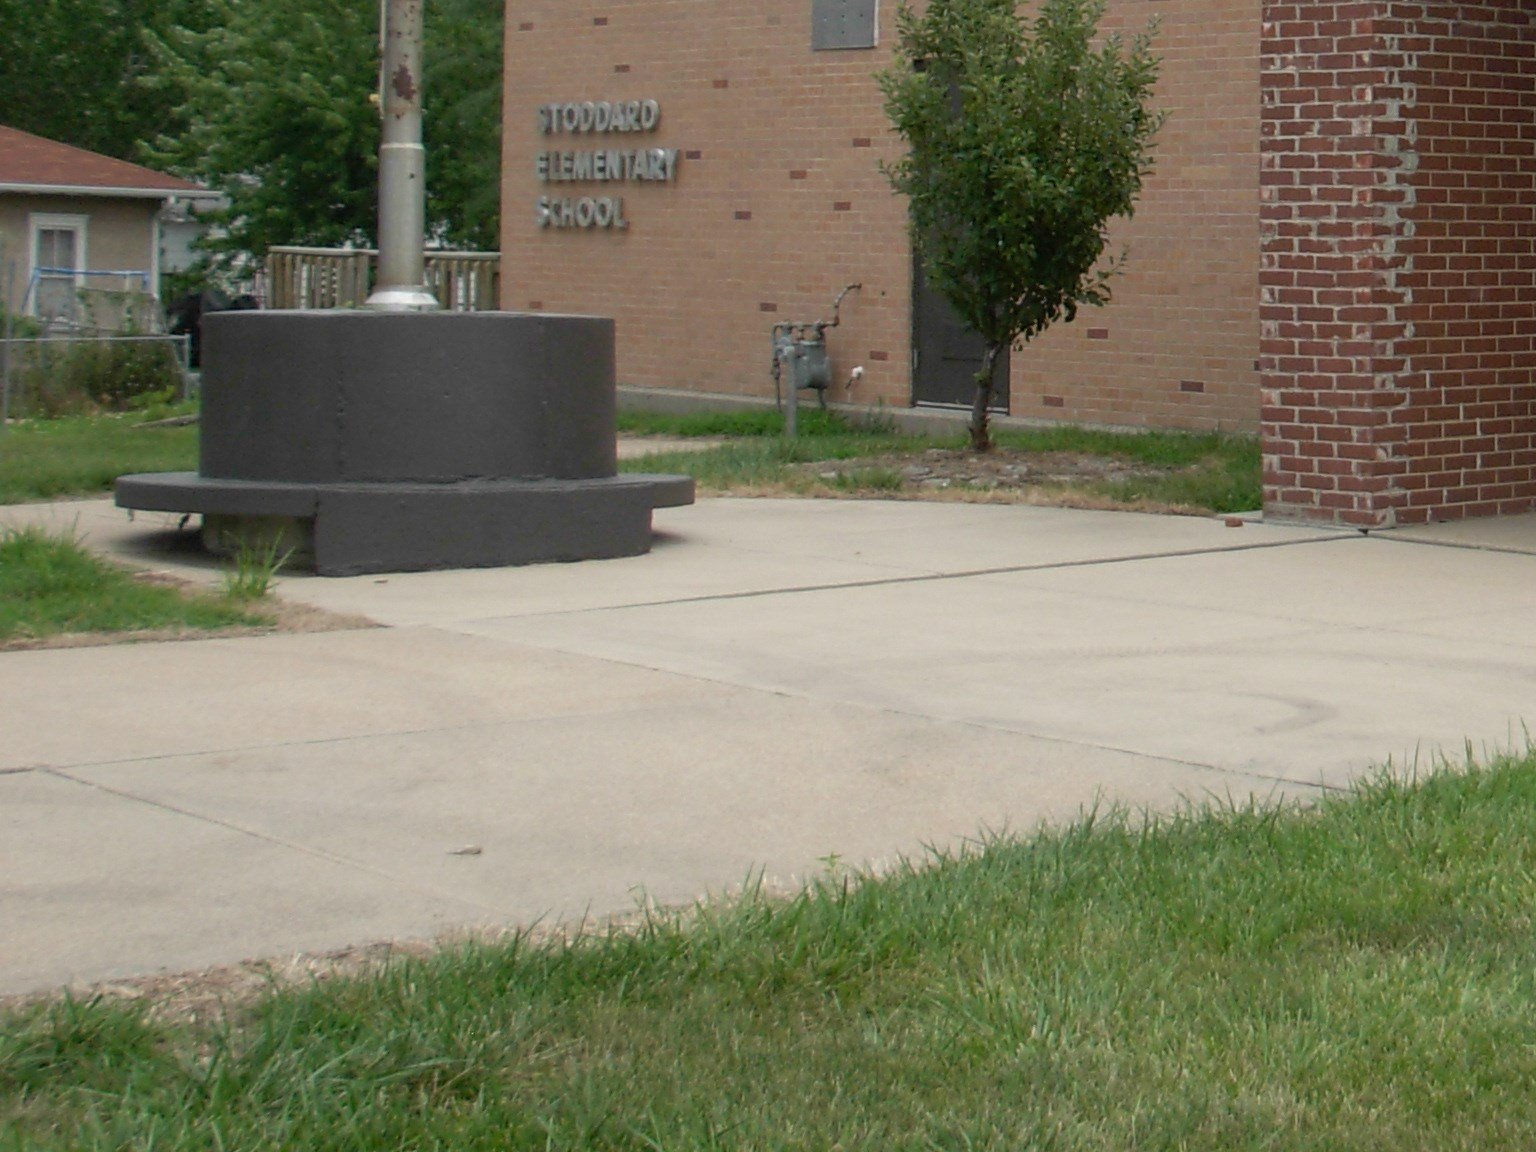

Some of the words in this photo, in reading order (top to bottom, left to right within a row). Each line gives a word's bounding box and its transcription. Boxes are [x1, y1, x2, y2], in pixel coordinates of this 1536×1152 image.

[538, 99, 661, 135] STODDARD
[536, 148, 680, 182] ELEMENTARY
[536, 195, 629, 229] SCHOOL
